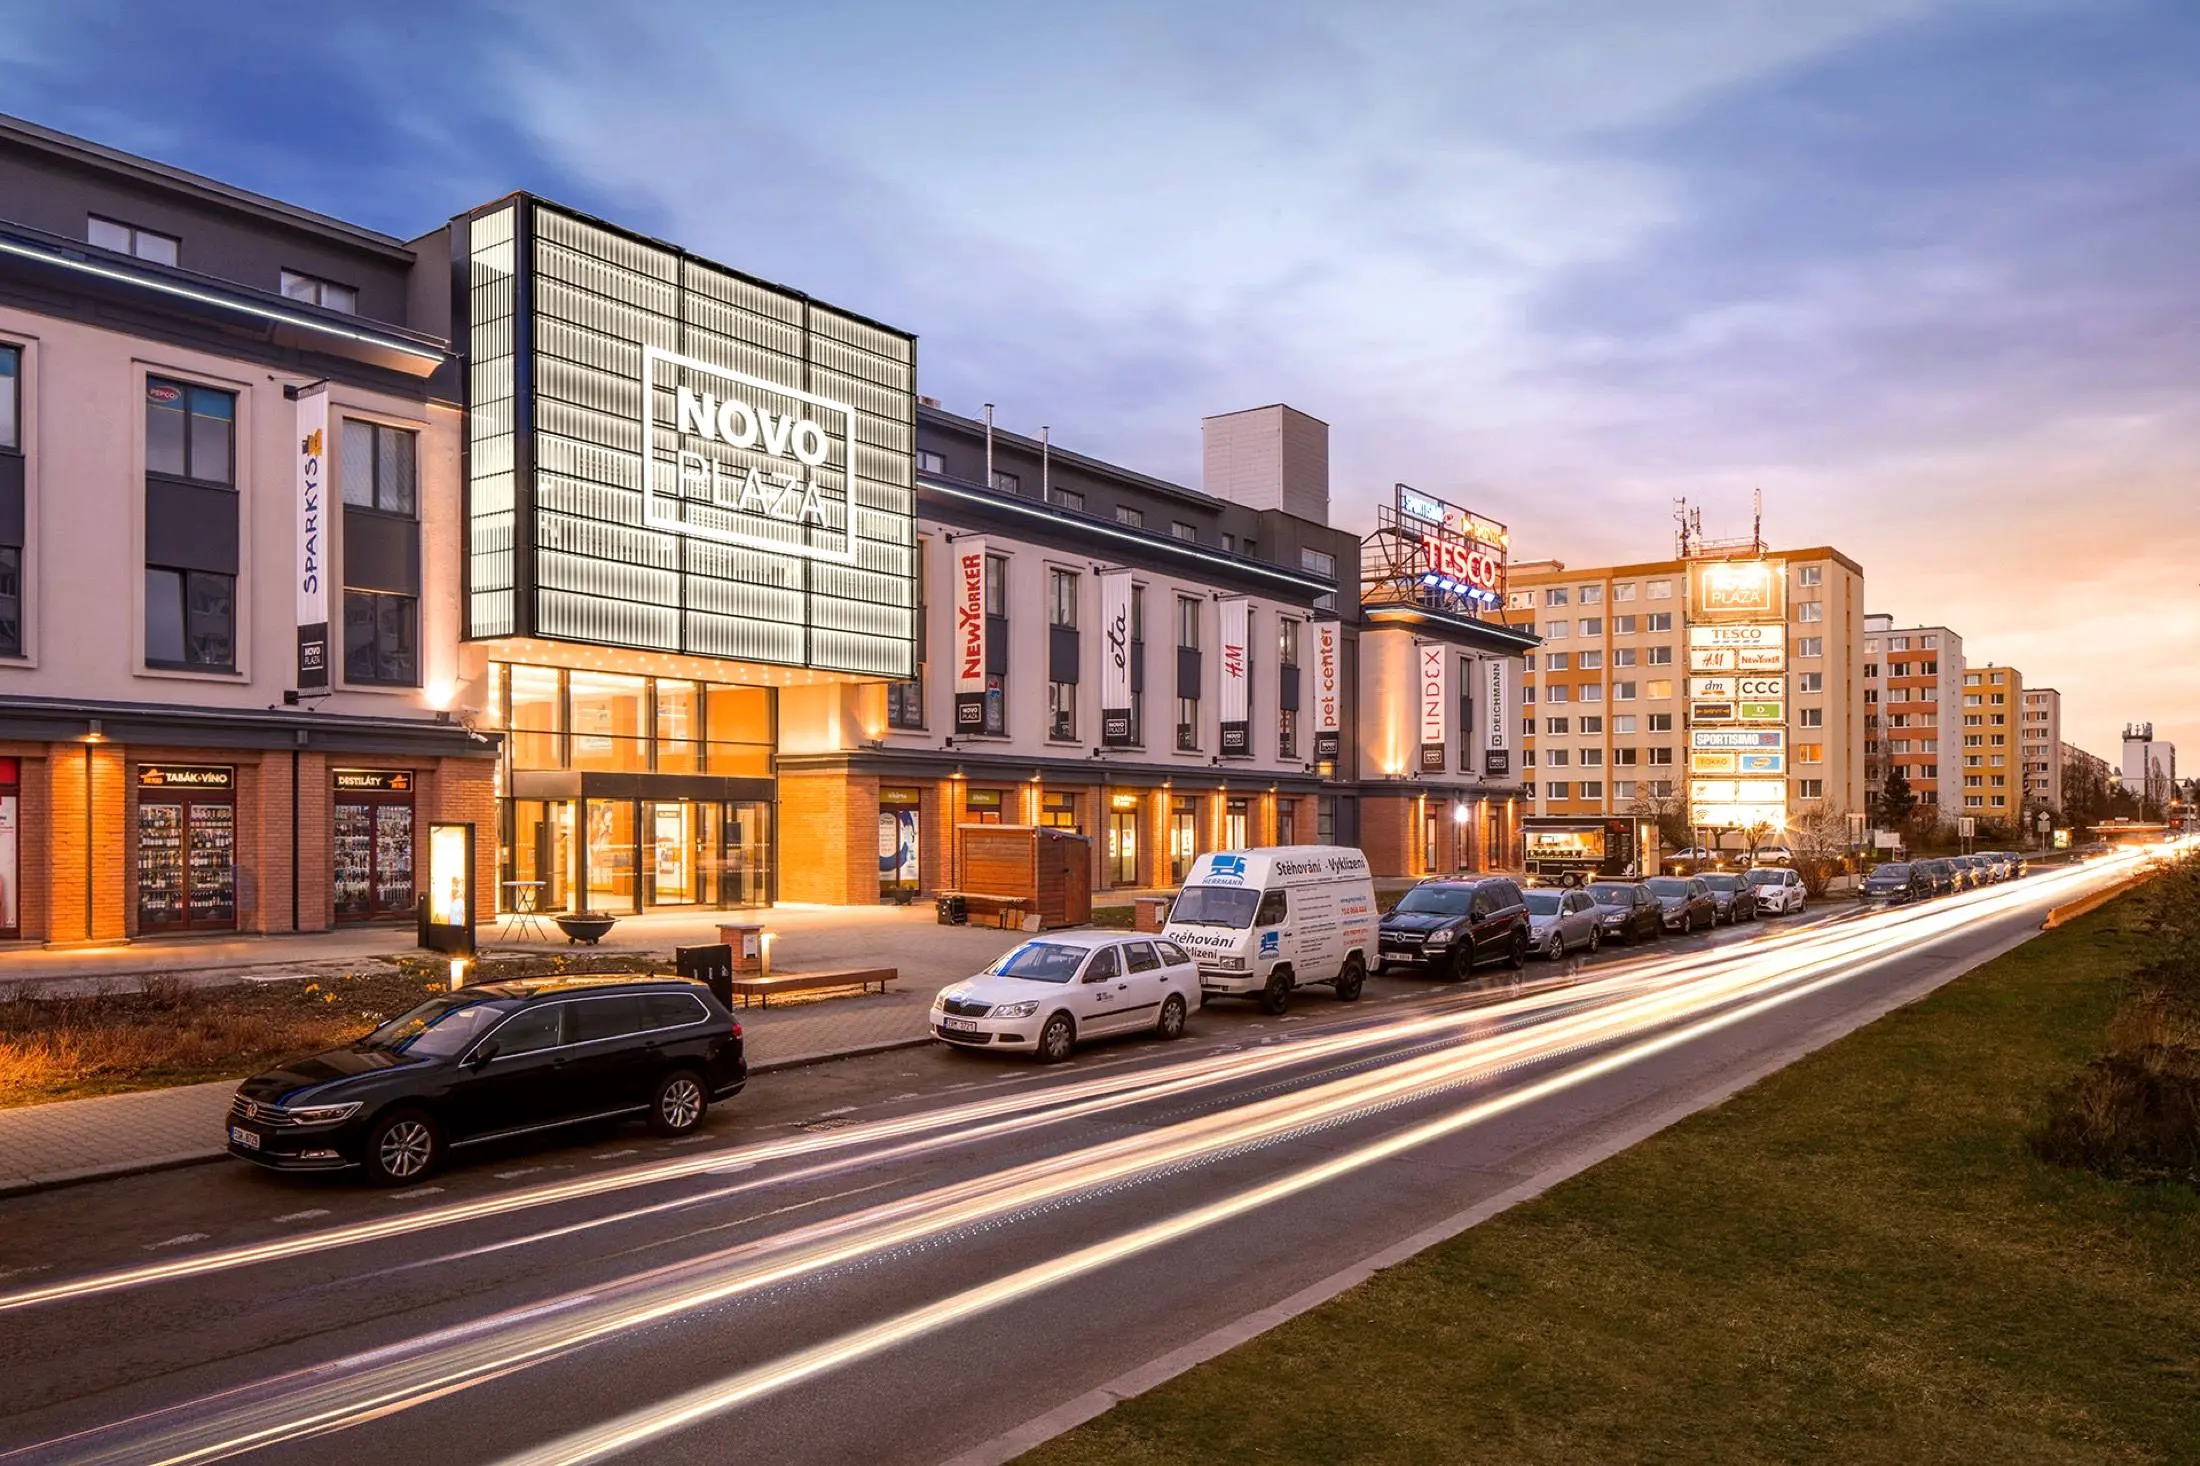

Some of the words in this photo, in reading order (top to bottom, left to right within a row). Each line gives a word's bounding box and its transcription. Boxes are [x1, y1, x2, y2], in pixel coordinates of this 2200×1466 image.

[677, 386, 828, 466] NOVO
[677, 449, 829, 529] PLAZA
[304, 457, 318, 594] SPARKYS
[1422, 534, 1496, 588] TESCO
[1711, 589, 1760, 604] PLAZA
[1107, 603, 1126, 683] eta
[1711, 628, 1762, 640] TESCO
[304, 646, 321, 656] NOVO
[1321, 627, 1335, 691] center
[1425, 650, 1440, 740] LINDEX
[1704, 680, 1723, 691] dm
[1742, 681, 1780, 694] CCC
[1493, 663, 1501, 732] DEICHMANN
[1321, 696, 1337, 727] pet
[1696, 733, 1759, 745] SPORTISIMO
[165, 771, 198, 782] TABÁK
[201, 772, 228, 783] VÍNO
[338, 775, 383, 786] DESTILÁTY
[1276, 860, 1322, 876] Stěhování
[1328, 857, 1366, 874] Vyklízení
[1168, 929, 1236, 948] Stěhování
[1185, 946, 1218, 959] klízení
